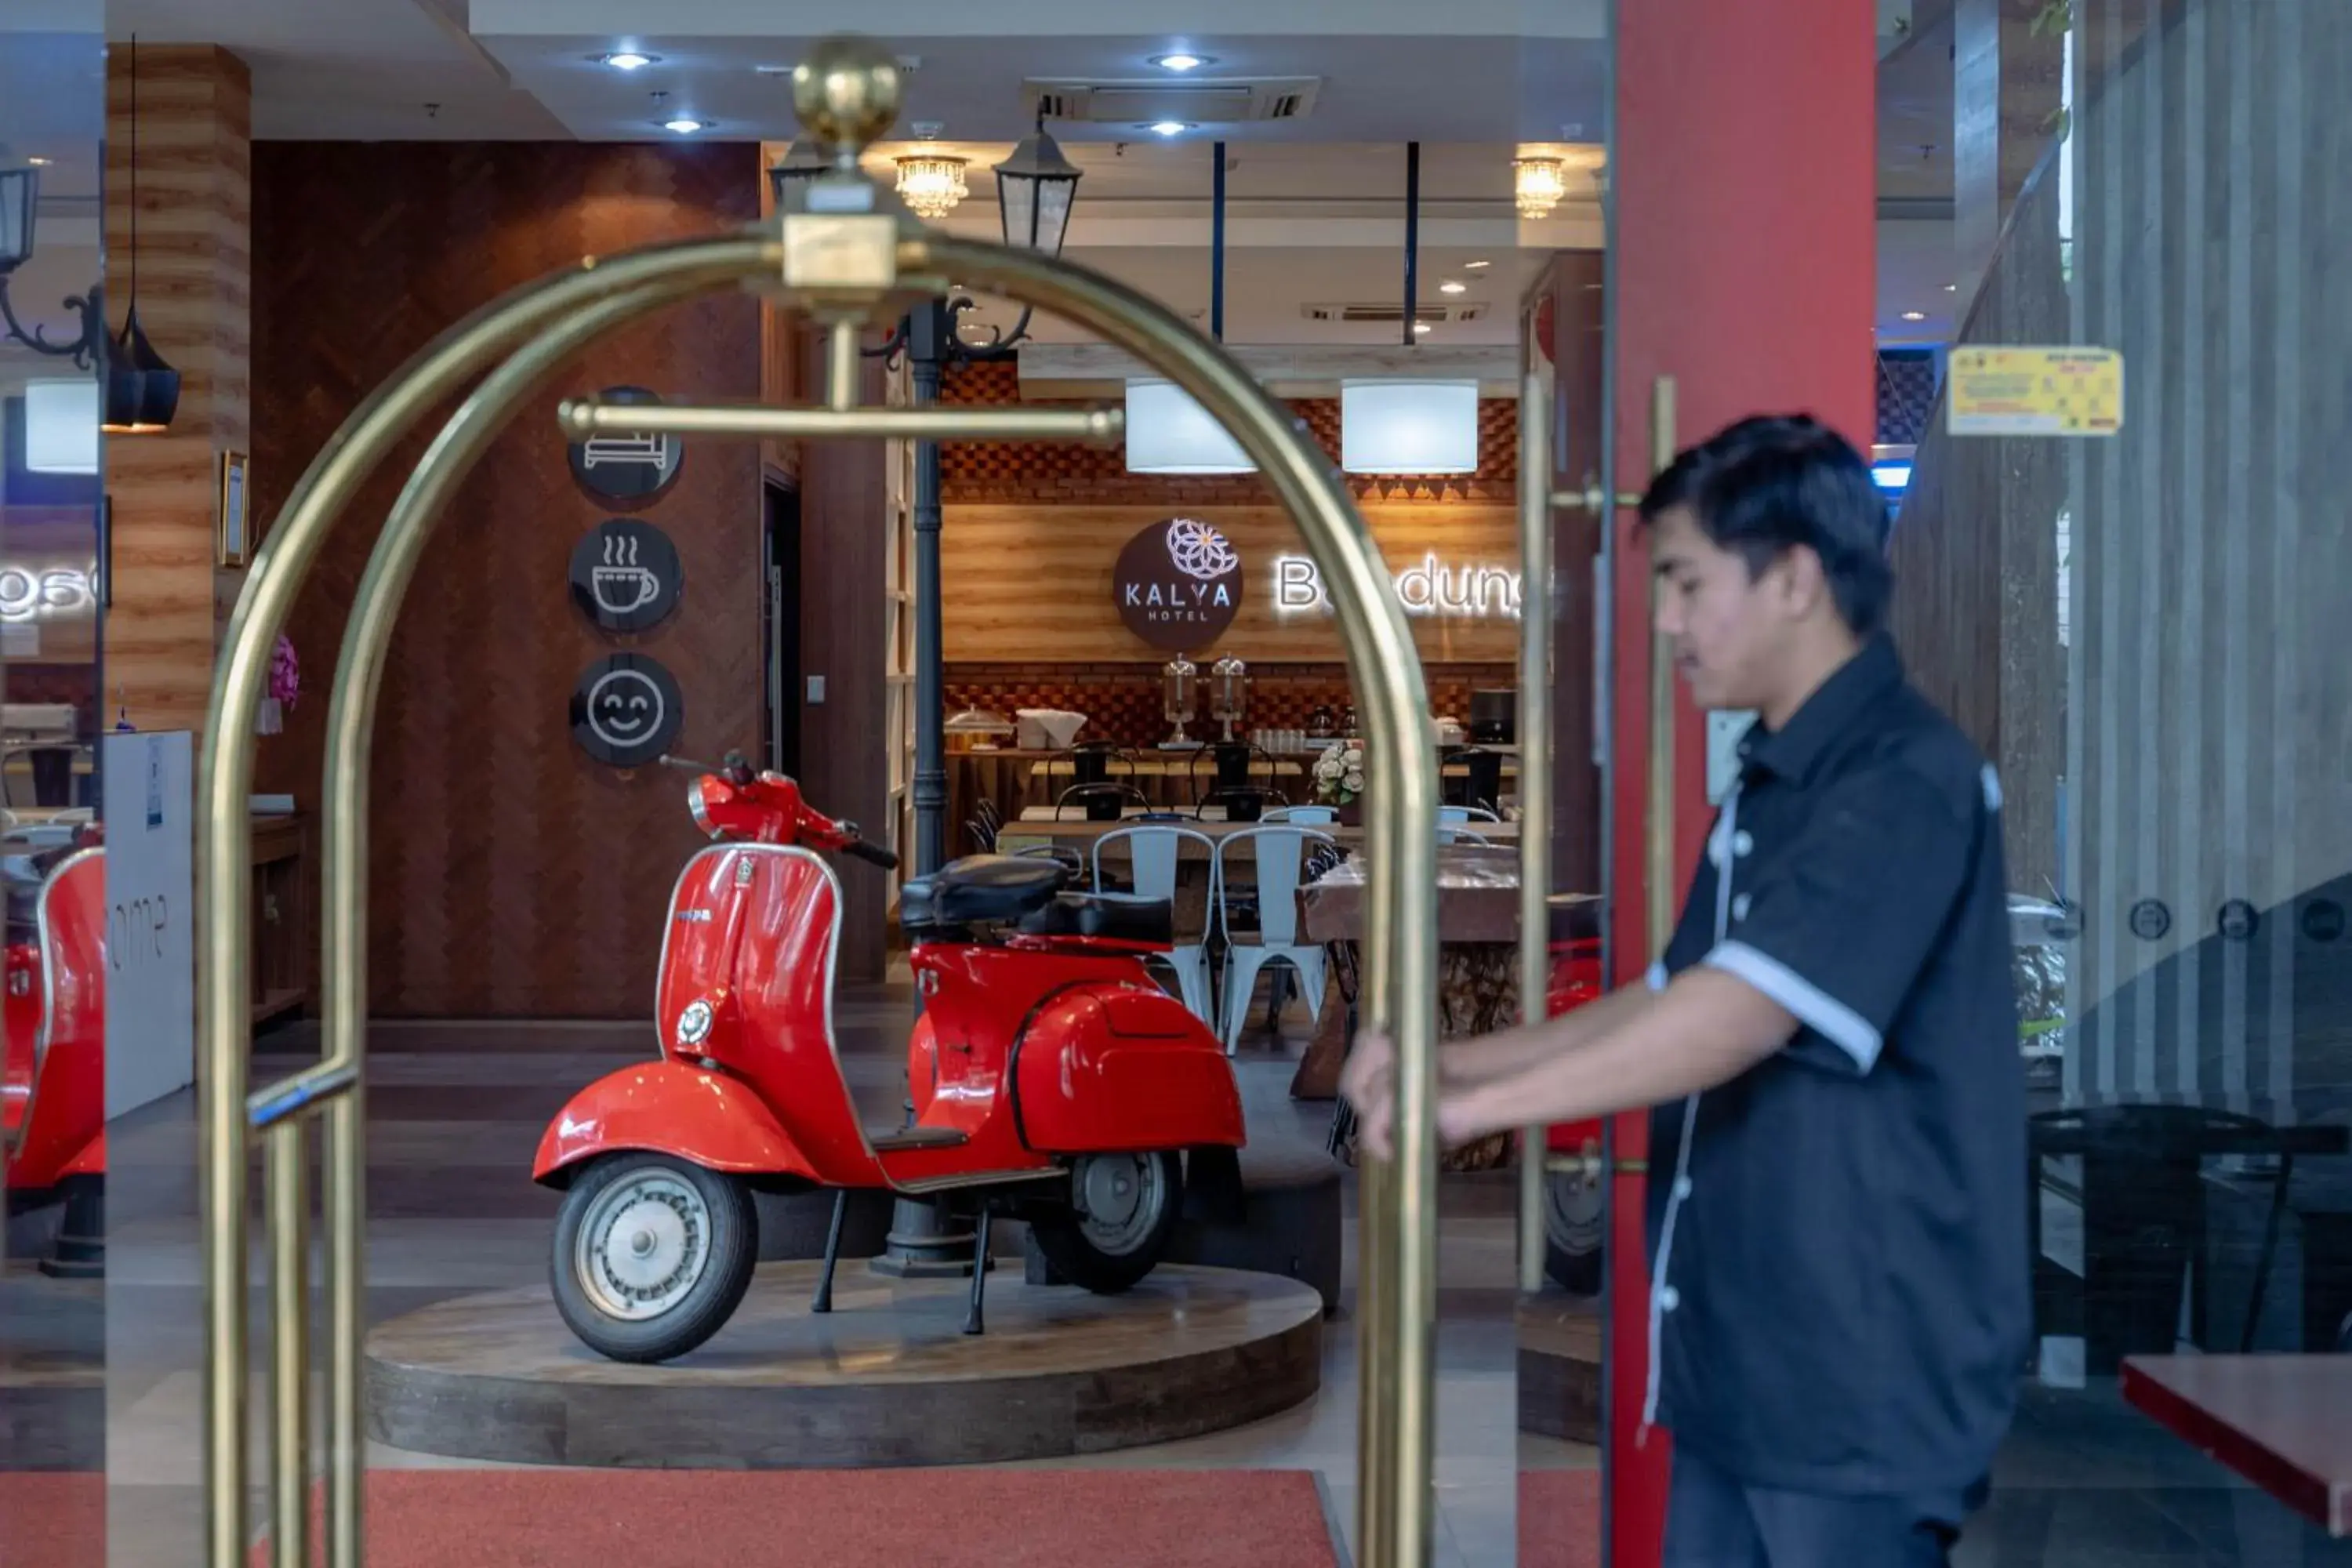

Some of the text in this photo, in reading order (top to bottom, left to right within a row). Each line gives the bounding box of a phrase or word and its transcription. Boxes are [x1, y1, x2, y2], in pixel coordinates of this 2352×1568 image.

[1125, 583, 1230, 608] KALYA
[1279, 554, 1523, 615] Bdun
[1149, 611, 1208, 622] HOTEL
